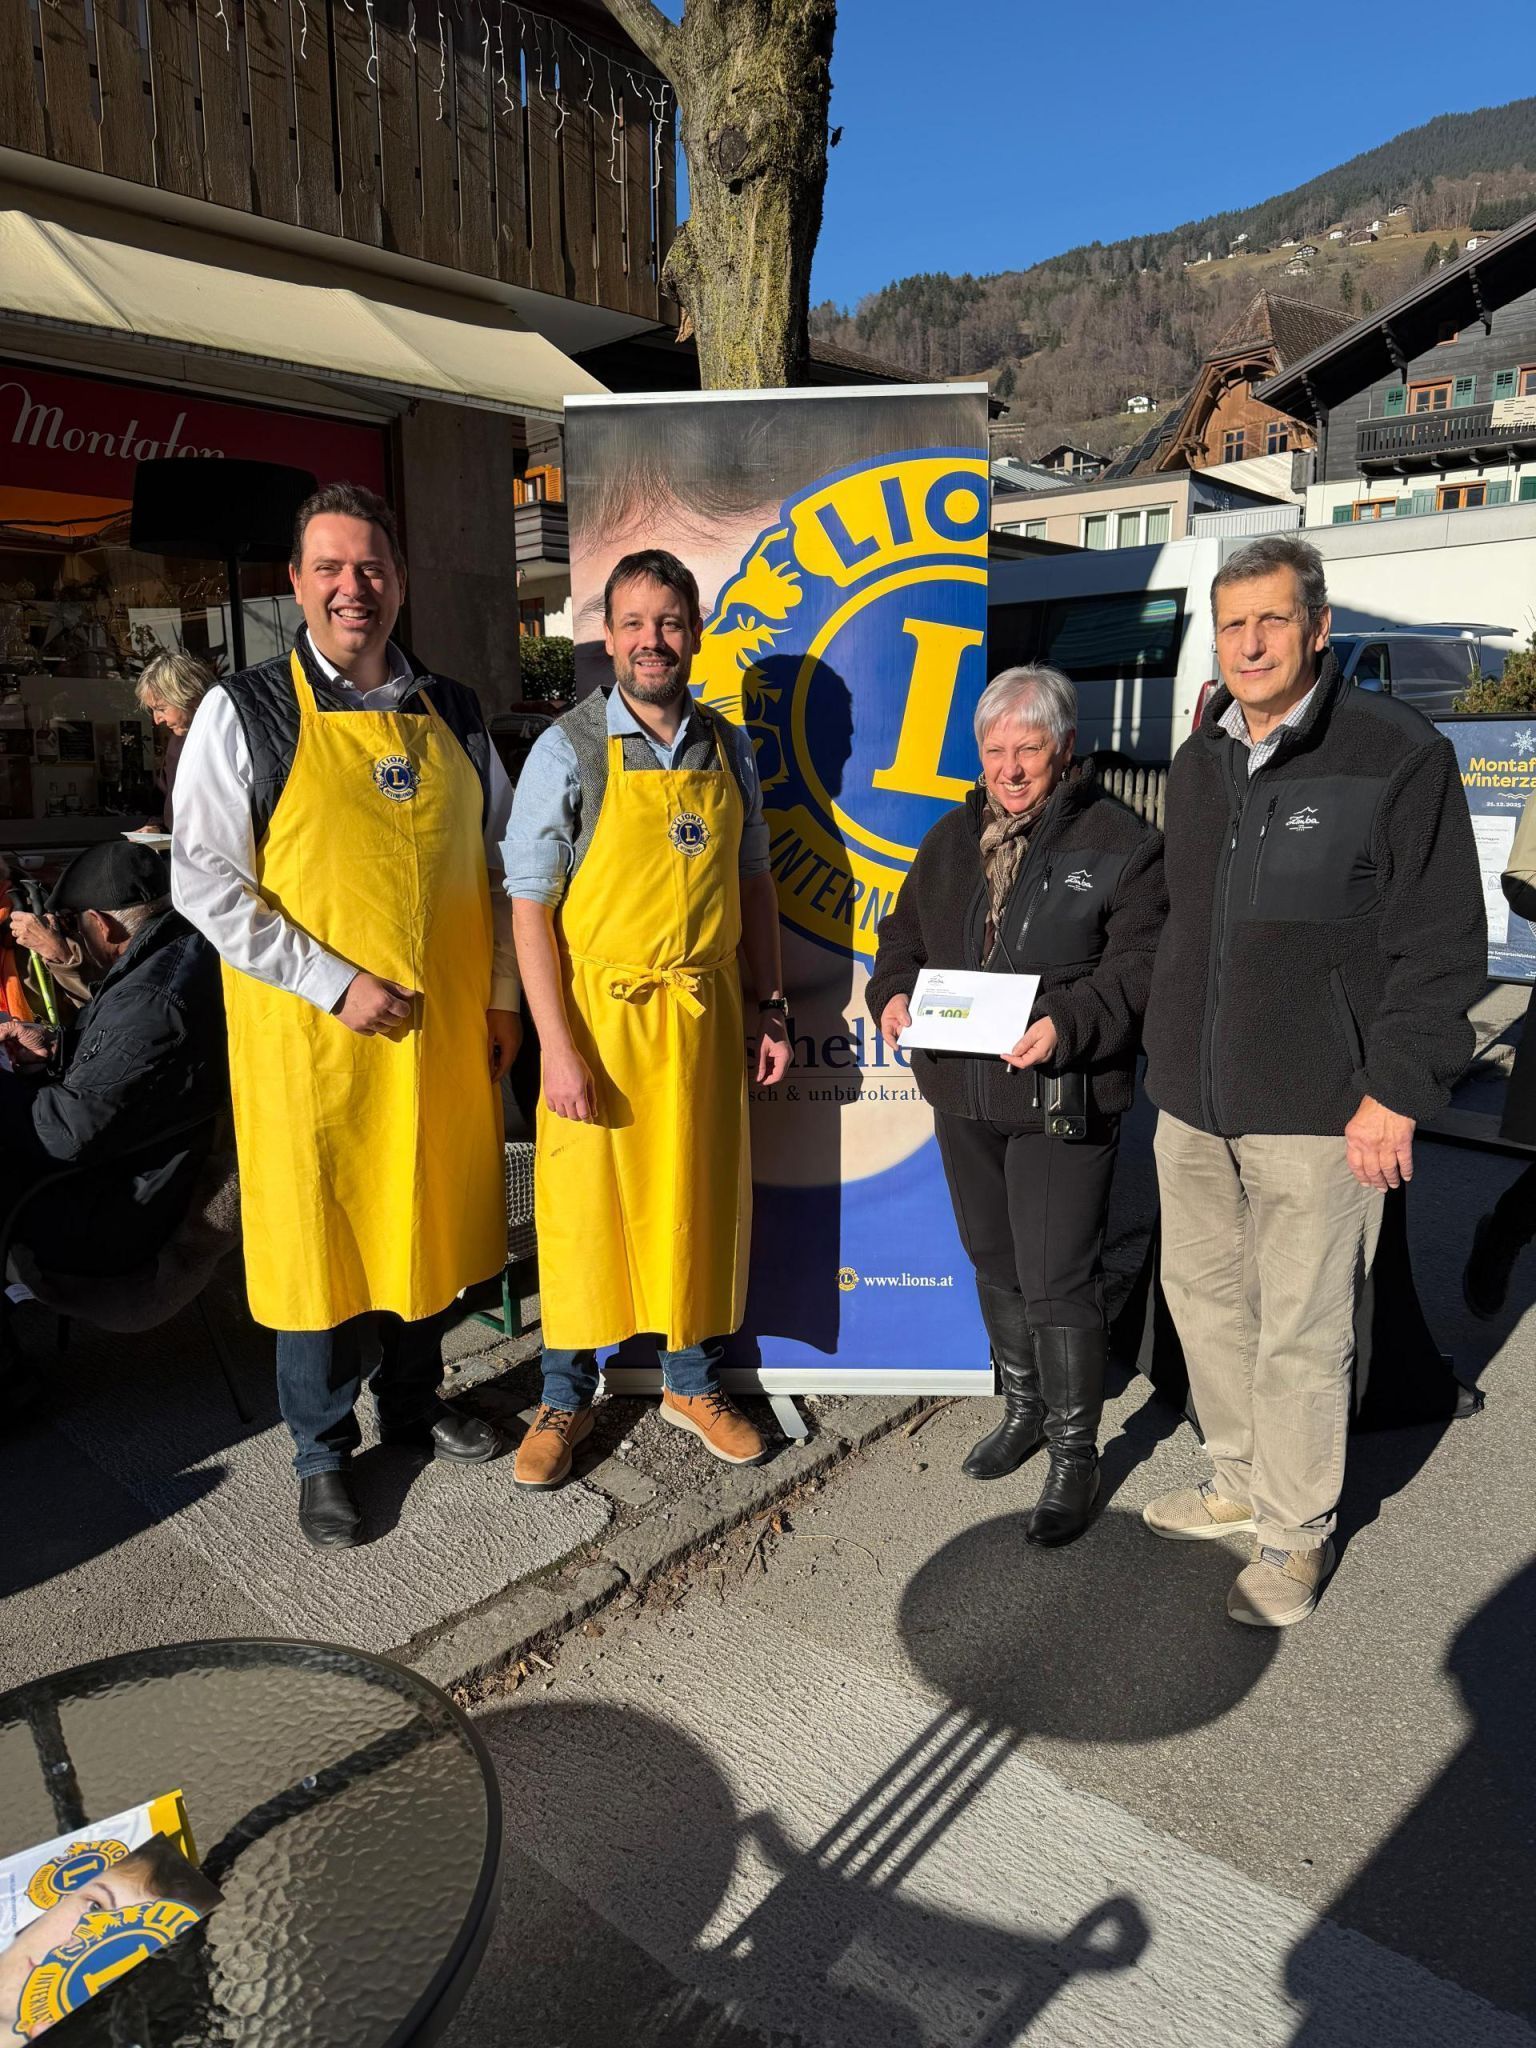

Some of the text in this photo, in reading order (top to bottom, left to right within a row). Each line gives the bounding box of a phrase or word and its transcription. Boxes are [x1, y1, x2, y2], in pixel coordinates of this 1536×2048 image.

[381, 756, 410, 768] LIONS
[391, 768, 406, 786] L
[677, 813, 702, 824] LIONS
[685, 825, 697, 842] L
[864, 1272, 954, 1287] www.lions.at
